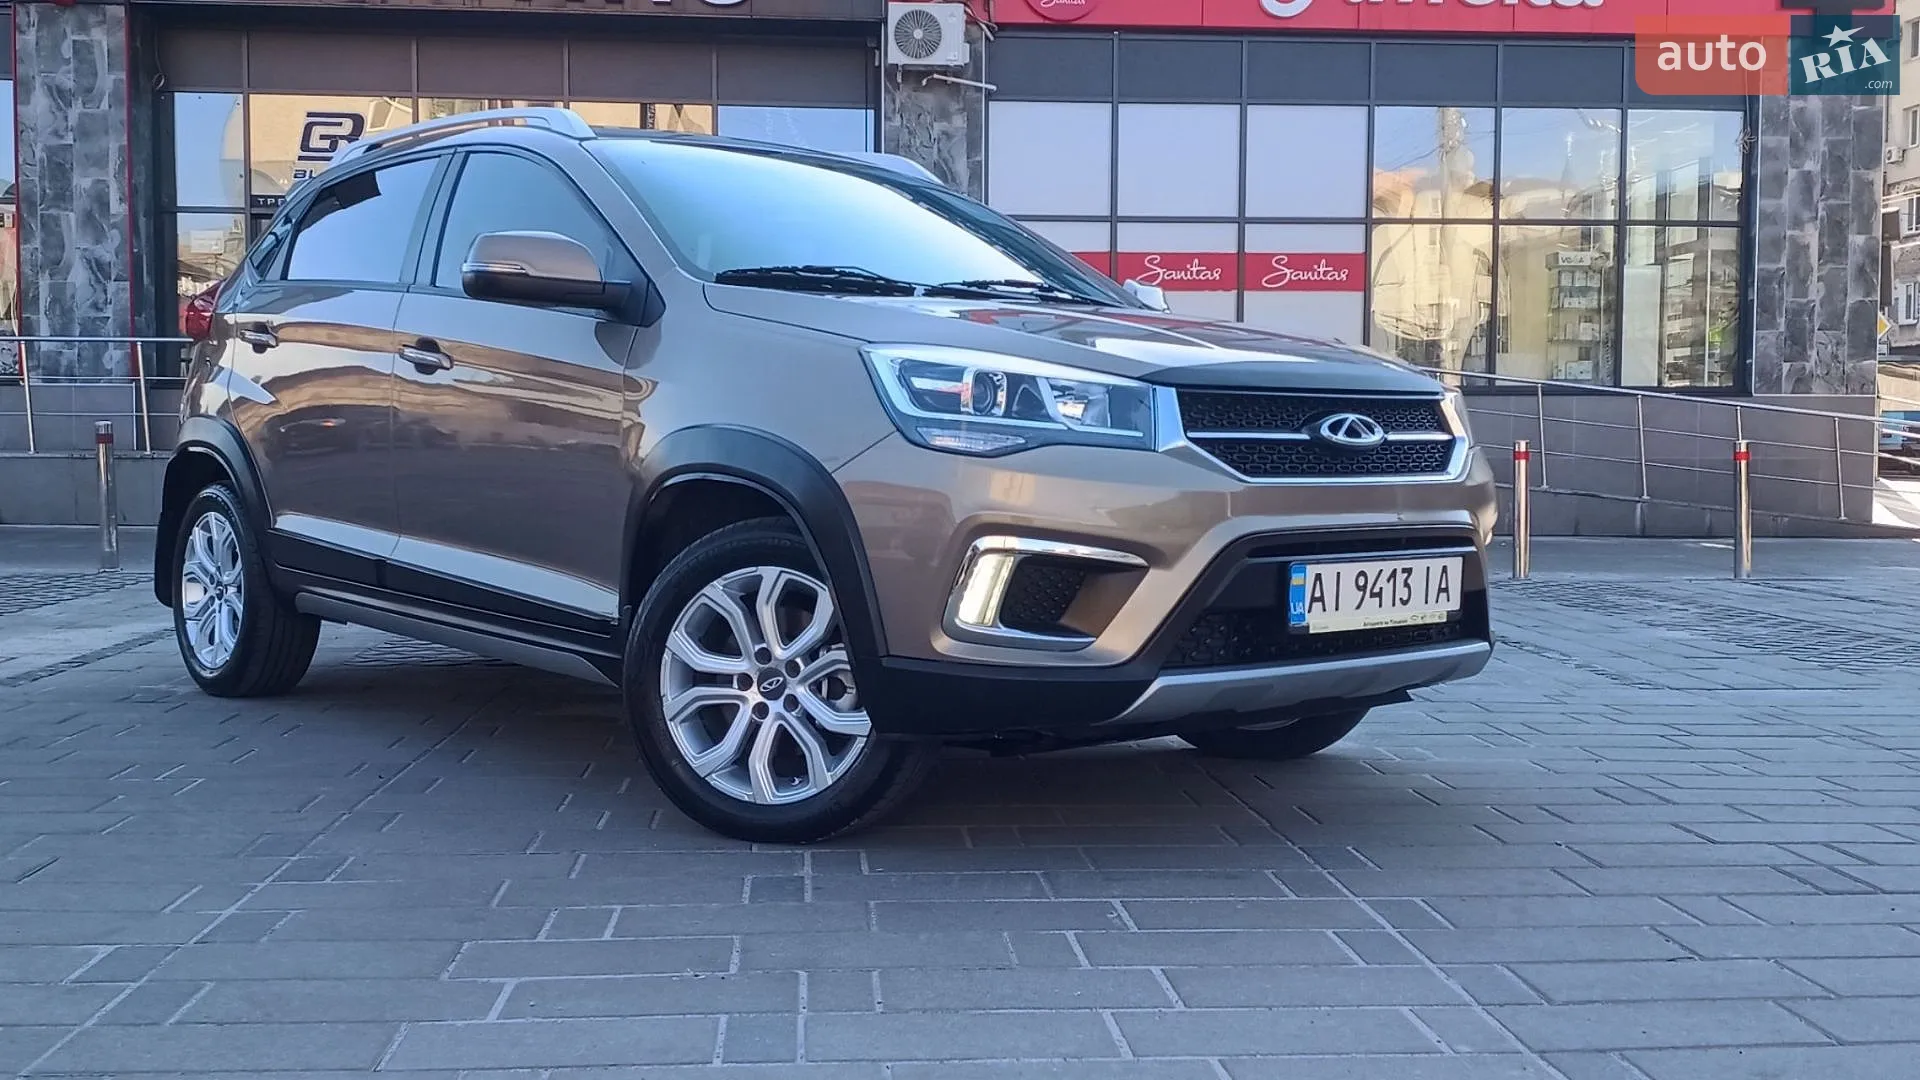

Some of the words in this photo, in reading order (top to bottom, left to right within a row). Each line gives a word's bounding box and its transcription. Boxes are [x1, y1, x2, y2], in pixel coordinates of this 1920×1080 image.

[1135, 255, 1222, 285] Sanitas
[1262, 255, 1349, 288] Sanitas
[1307, 571, 1341, 613] AI
[1354, 567, 1413, 610] 9413
[1424, 565, 1451, 604] IA
[1291, 602, 1305, 615] UA
